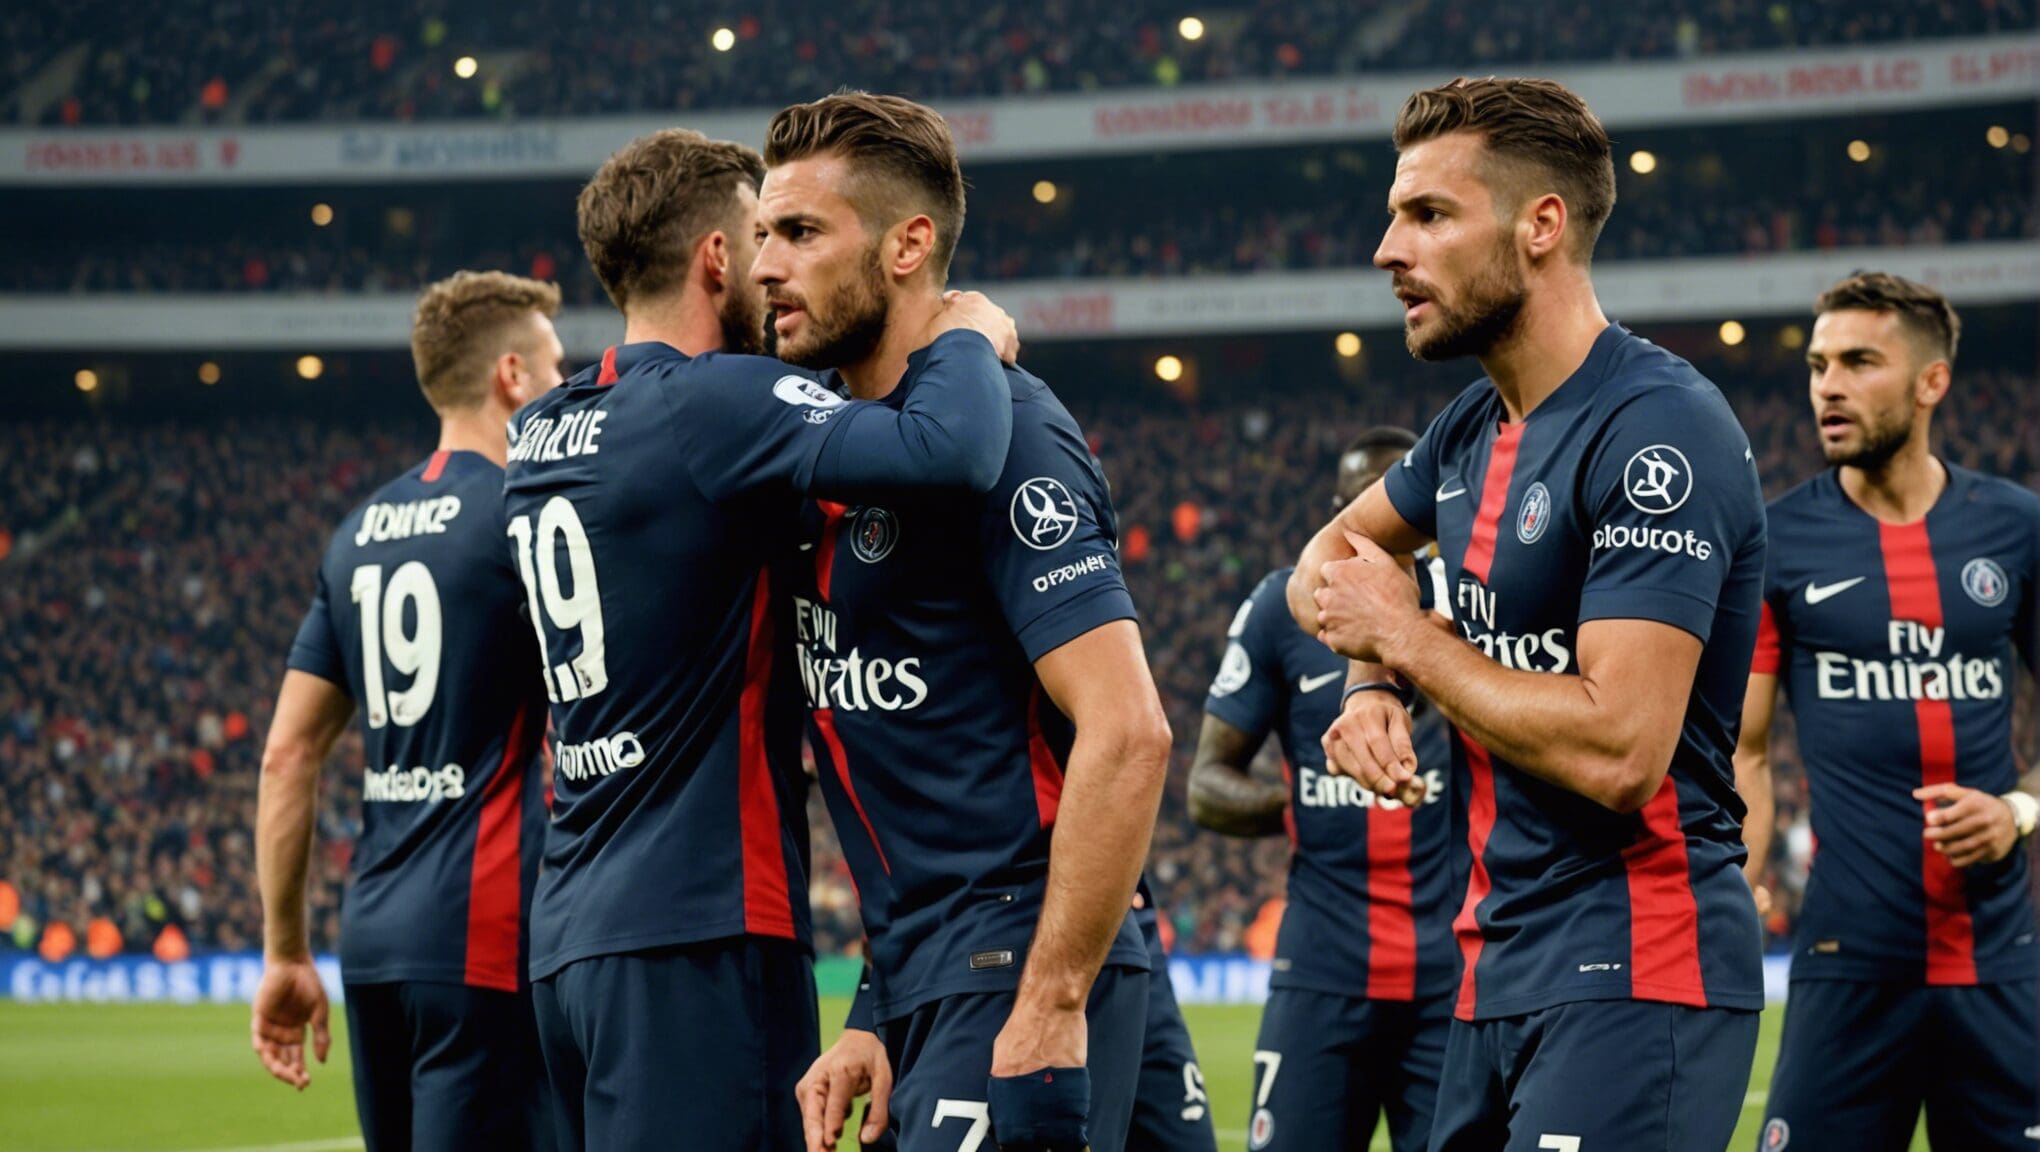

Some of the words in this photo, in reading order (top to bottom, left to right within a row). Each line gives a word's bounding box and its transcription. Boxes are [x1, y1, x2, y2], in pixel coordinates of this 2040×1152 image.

[351, 560, 442, 729] 19
[507, 495, 609, 704] 19
[931, 1098, 991, 1152] 7
[1253, 1050, 1282, 1107] 7
